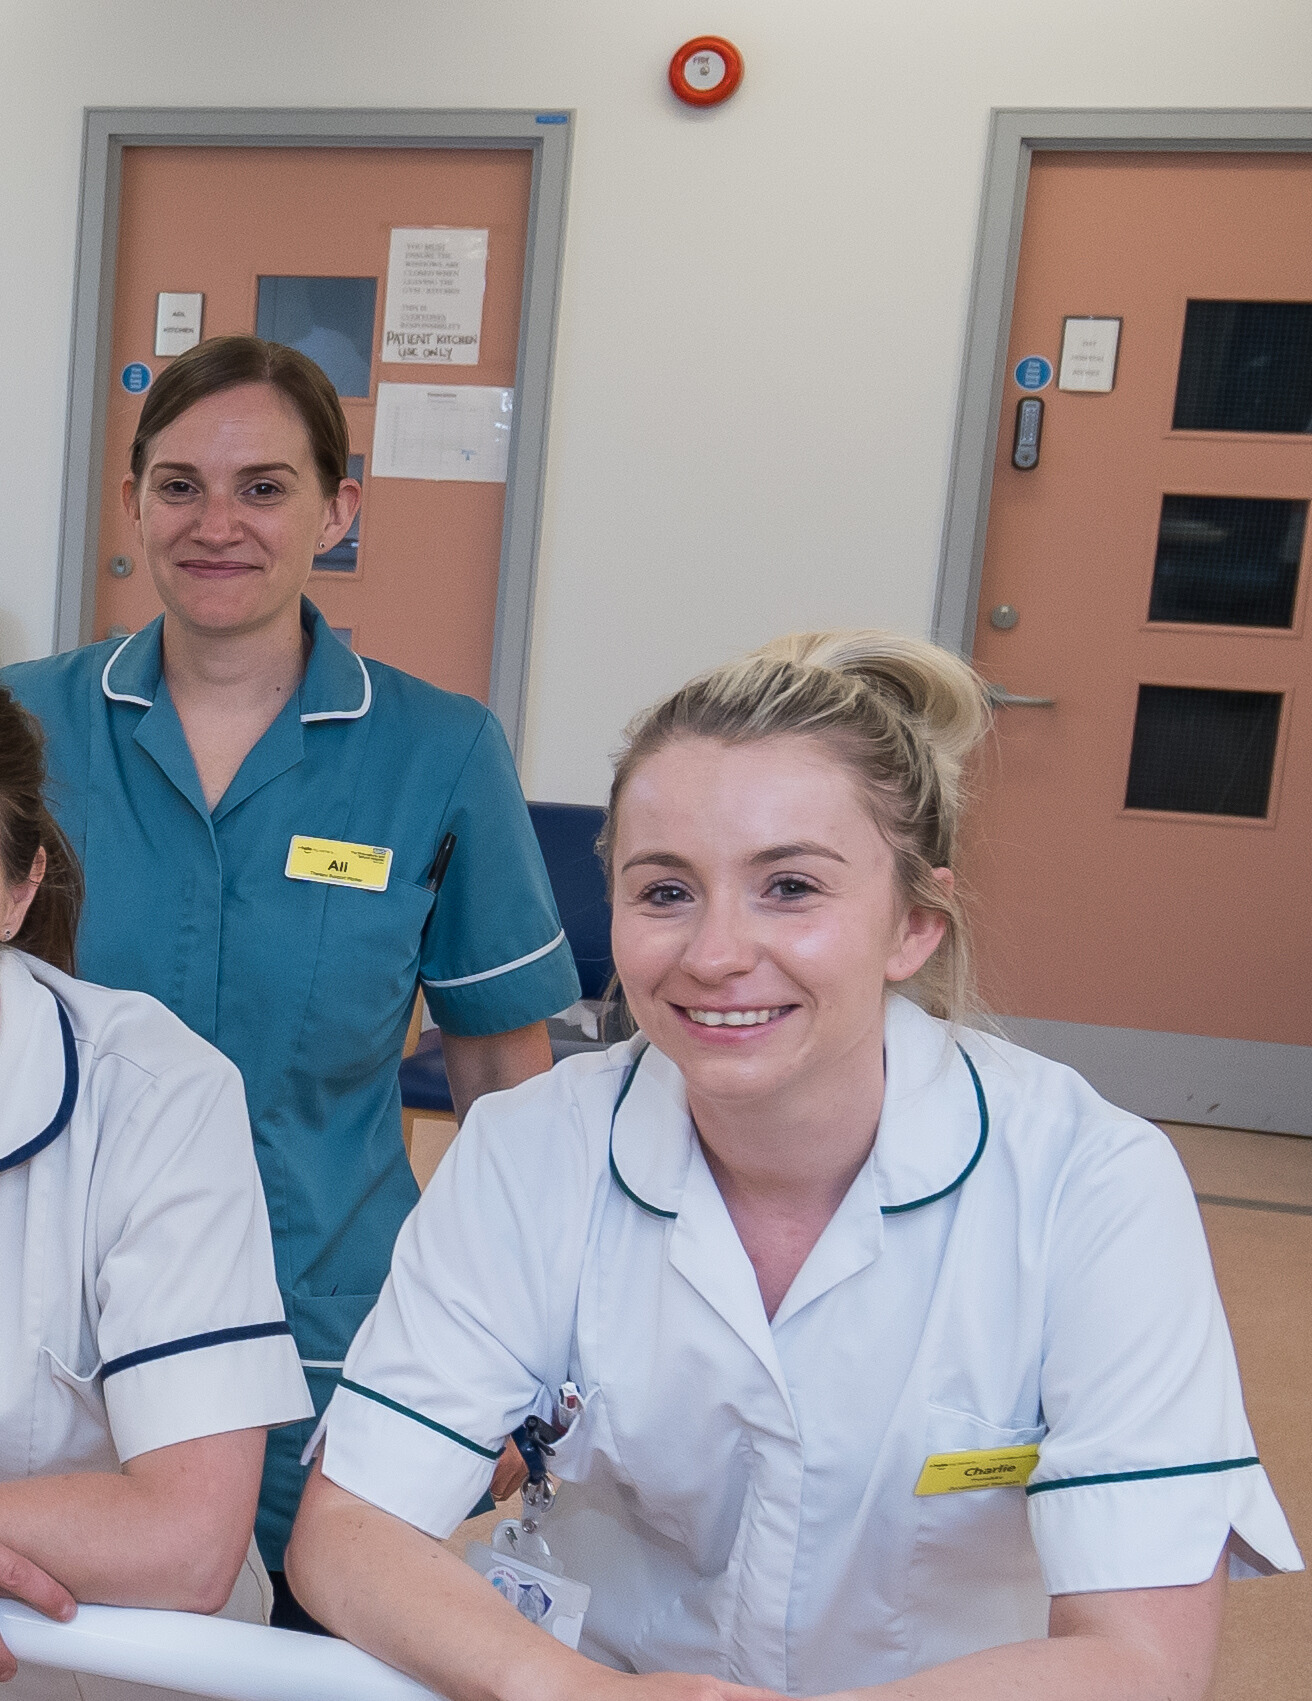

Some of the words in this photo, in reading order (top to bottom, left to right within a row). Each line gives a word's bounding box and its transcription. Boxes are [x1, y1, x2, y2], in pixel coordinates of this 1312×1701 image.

[386, 331, 433, 347] PATIENT
[436, 333, 478, 345] KITCHEN
[398, 347, 418, 357] USE
[422, 347, 453, 359] ONLY
[328, 860, 349, 873] Ali
[964, 1464, 1017, 1477] Charlie
